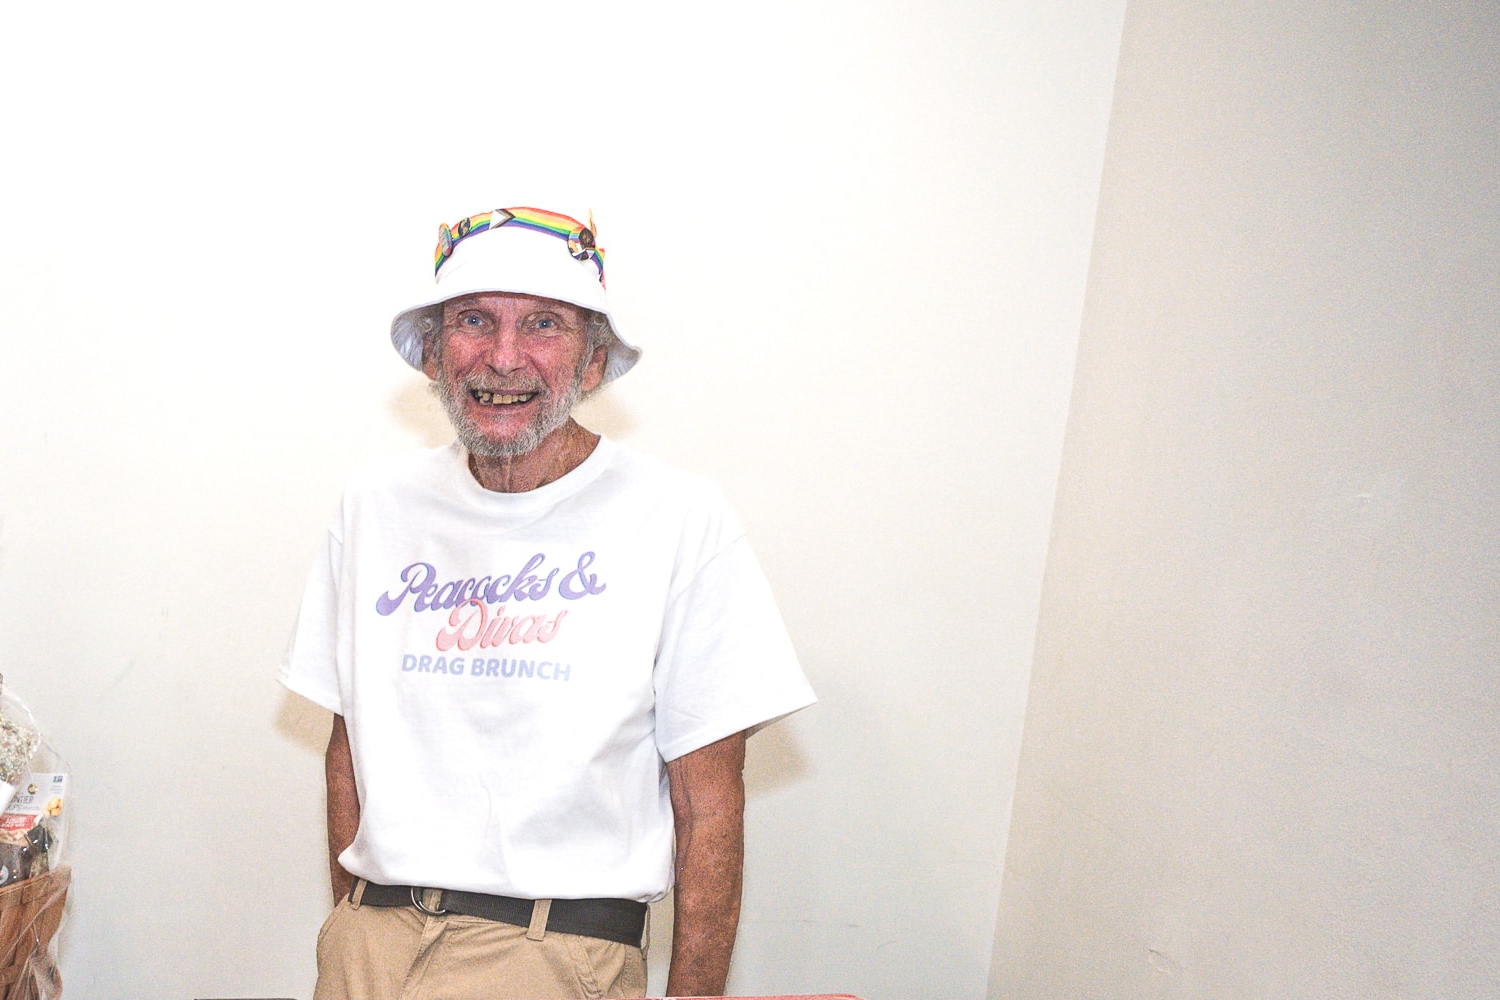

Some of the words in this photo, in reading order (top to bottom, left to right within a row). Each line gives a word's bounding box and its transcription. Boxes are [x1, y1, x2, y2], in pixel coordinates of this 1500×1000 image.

[376, 553, 560, 616] Peacocks
[558, 551, 607, 600] &
[436, 598, 569, 651] Divas
[401, 653, 465, 676] DRAG
[470, 657, 572, 682] BRUNCH
